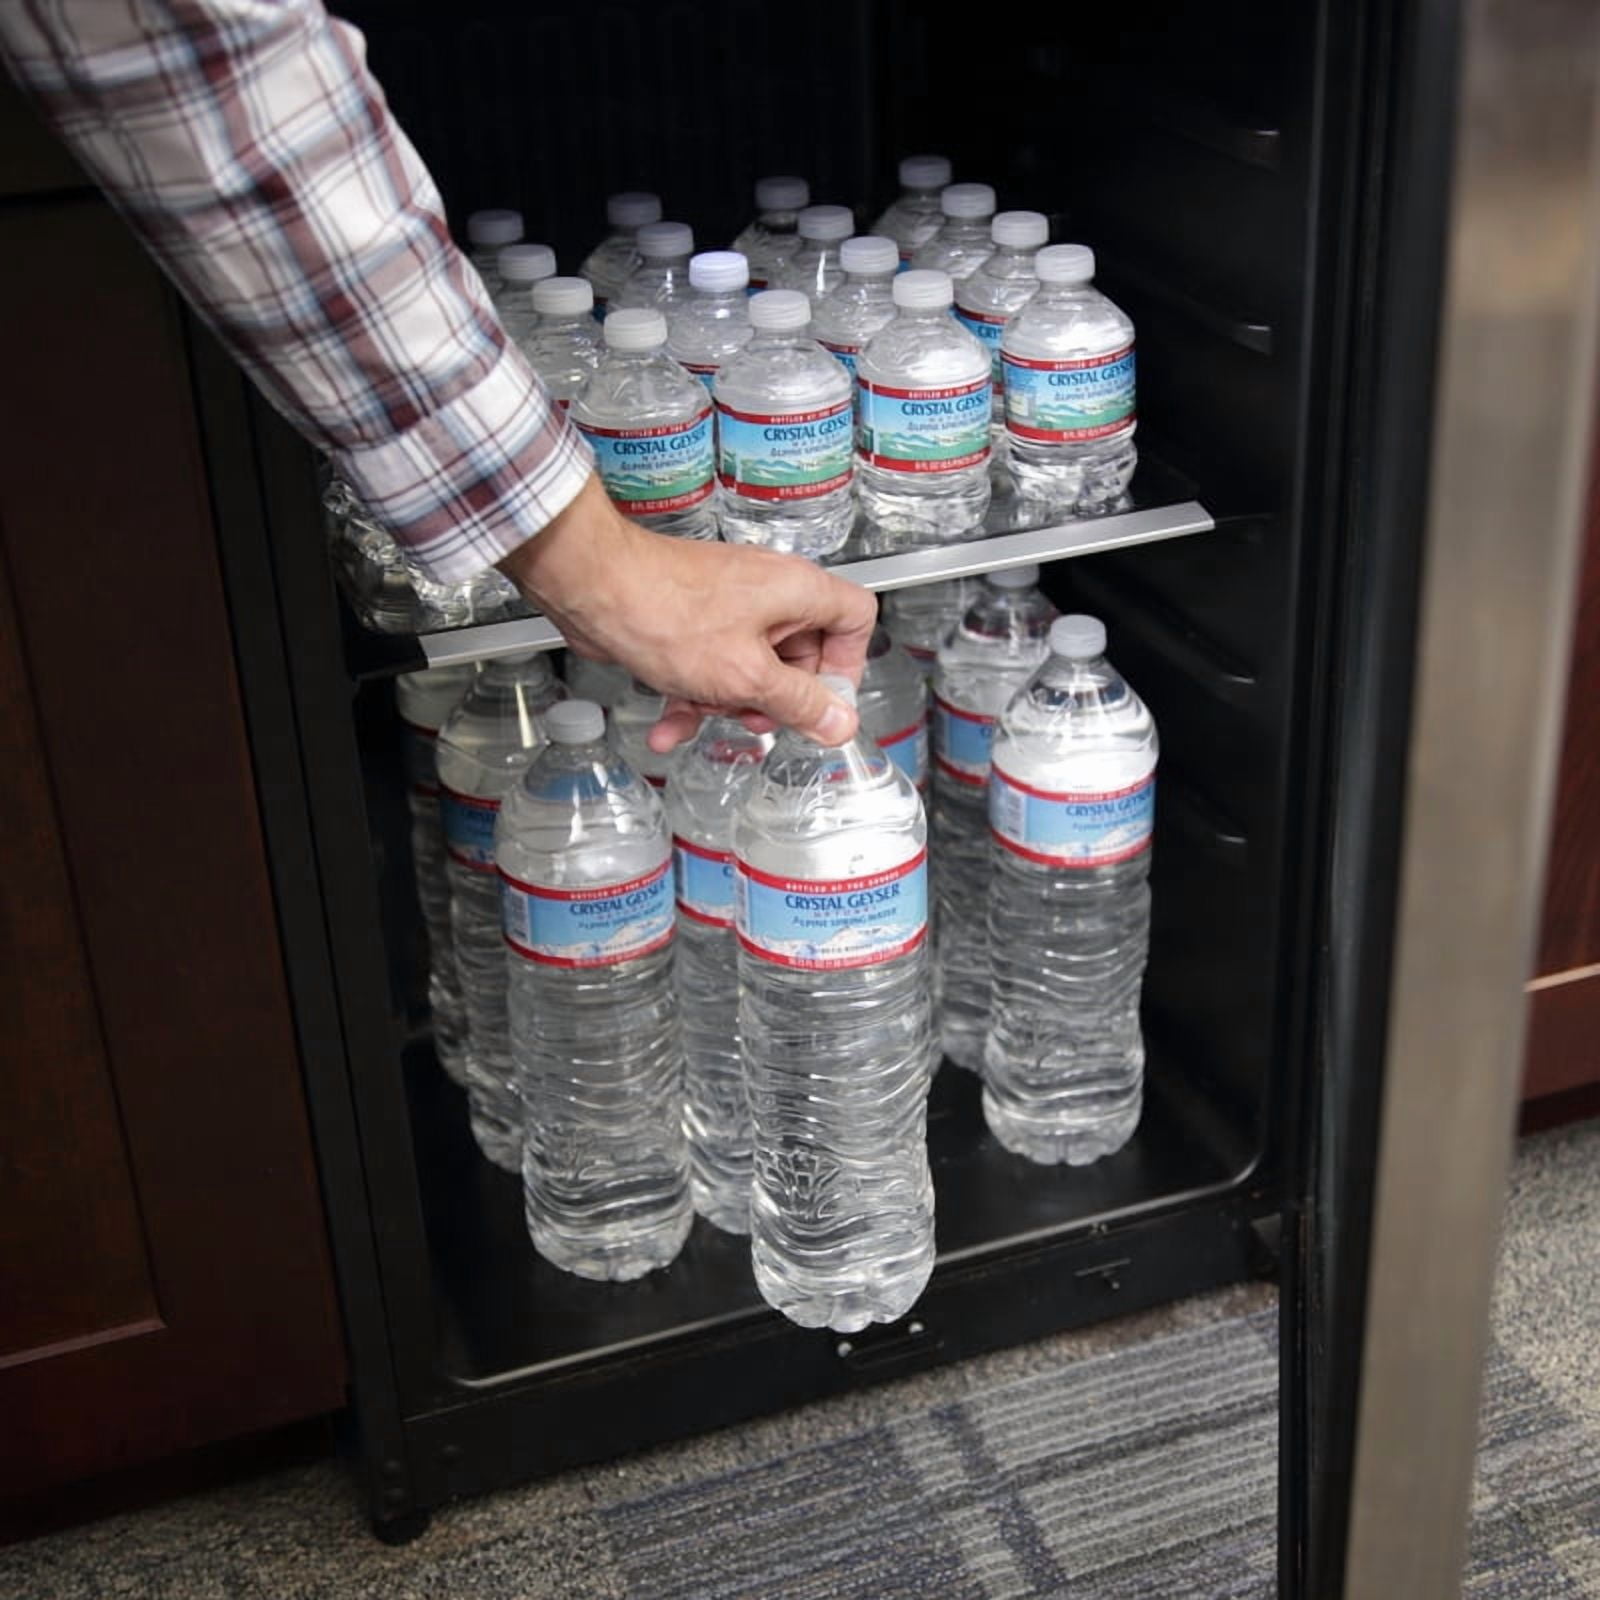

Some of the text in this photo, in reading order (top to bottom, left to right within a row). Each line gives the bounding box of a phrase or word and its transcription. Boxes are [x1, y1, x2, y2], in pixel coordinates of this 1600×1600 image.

[1047, 371, 1099, 387] CRYSTAL
[901, 400, 954, 417] CRYSTAL
[763, 425, 816, 441] CRYSTAL
[613, 440, 667, 456] CRYSTAL
[1065, 803, 1116, 818] CRYSTAL
[785, 882, 901, 911] CRYSTAL GEYSER
[570, 899, 623, 916] CRYSTAL
